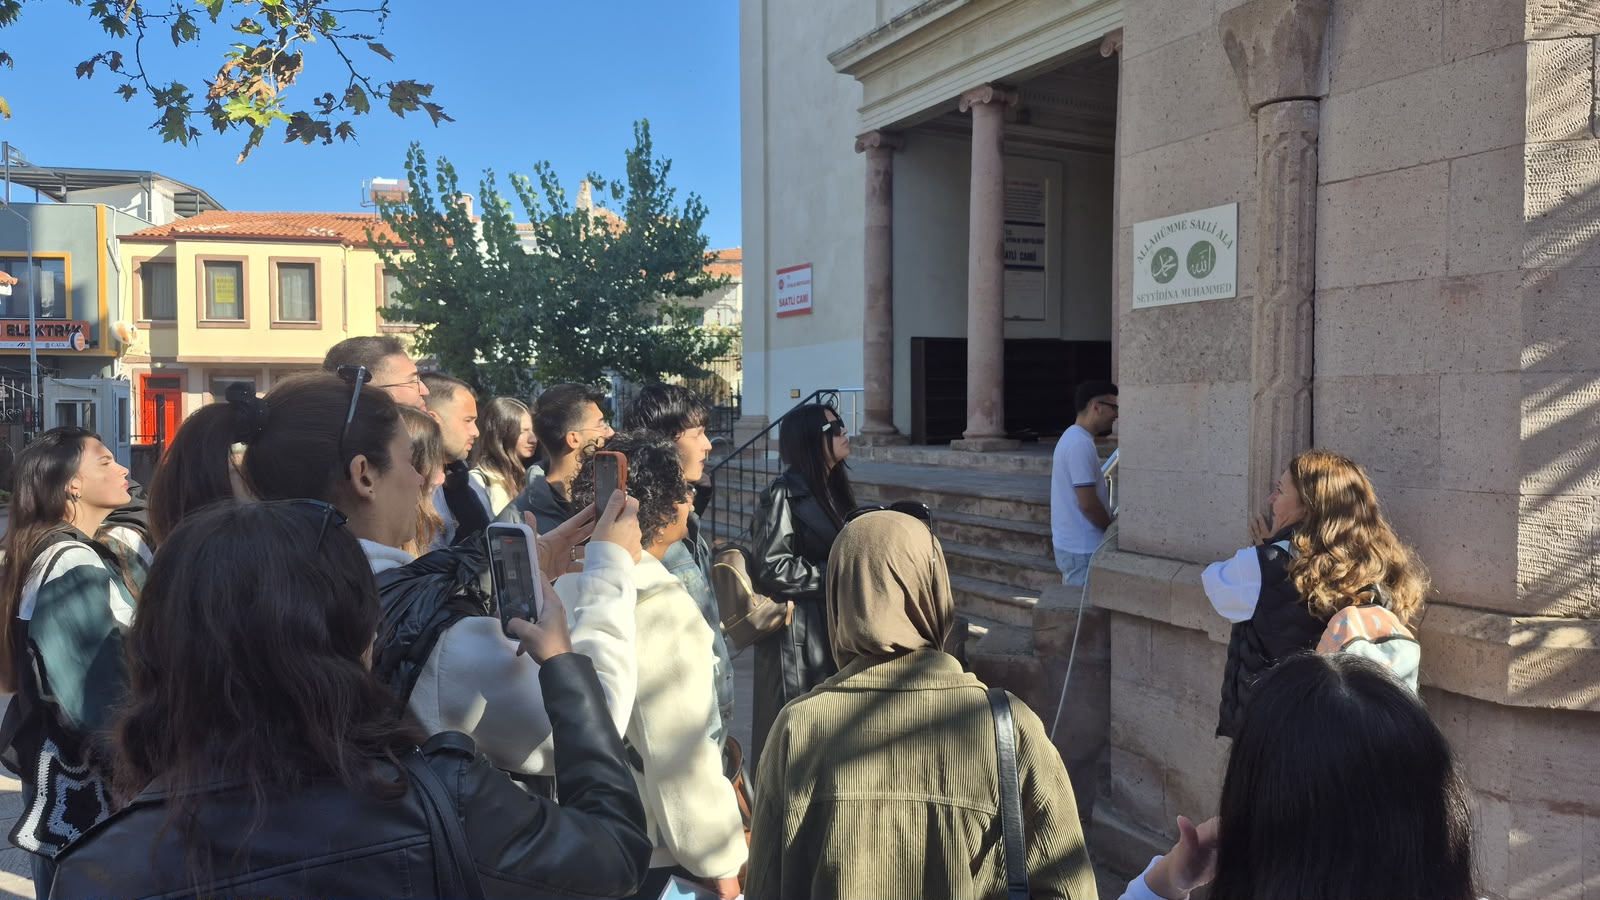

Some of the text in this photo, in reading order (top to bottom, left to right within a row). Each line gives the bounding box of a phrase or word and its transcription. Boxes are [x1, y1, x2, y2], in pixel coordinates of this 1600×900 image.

[1137, 220, 1187, 263] ALLAHÜMME
[1190, 219, 1218, 234] SALLİ
[1181, 283, 1232, 298] MUHAMMED
